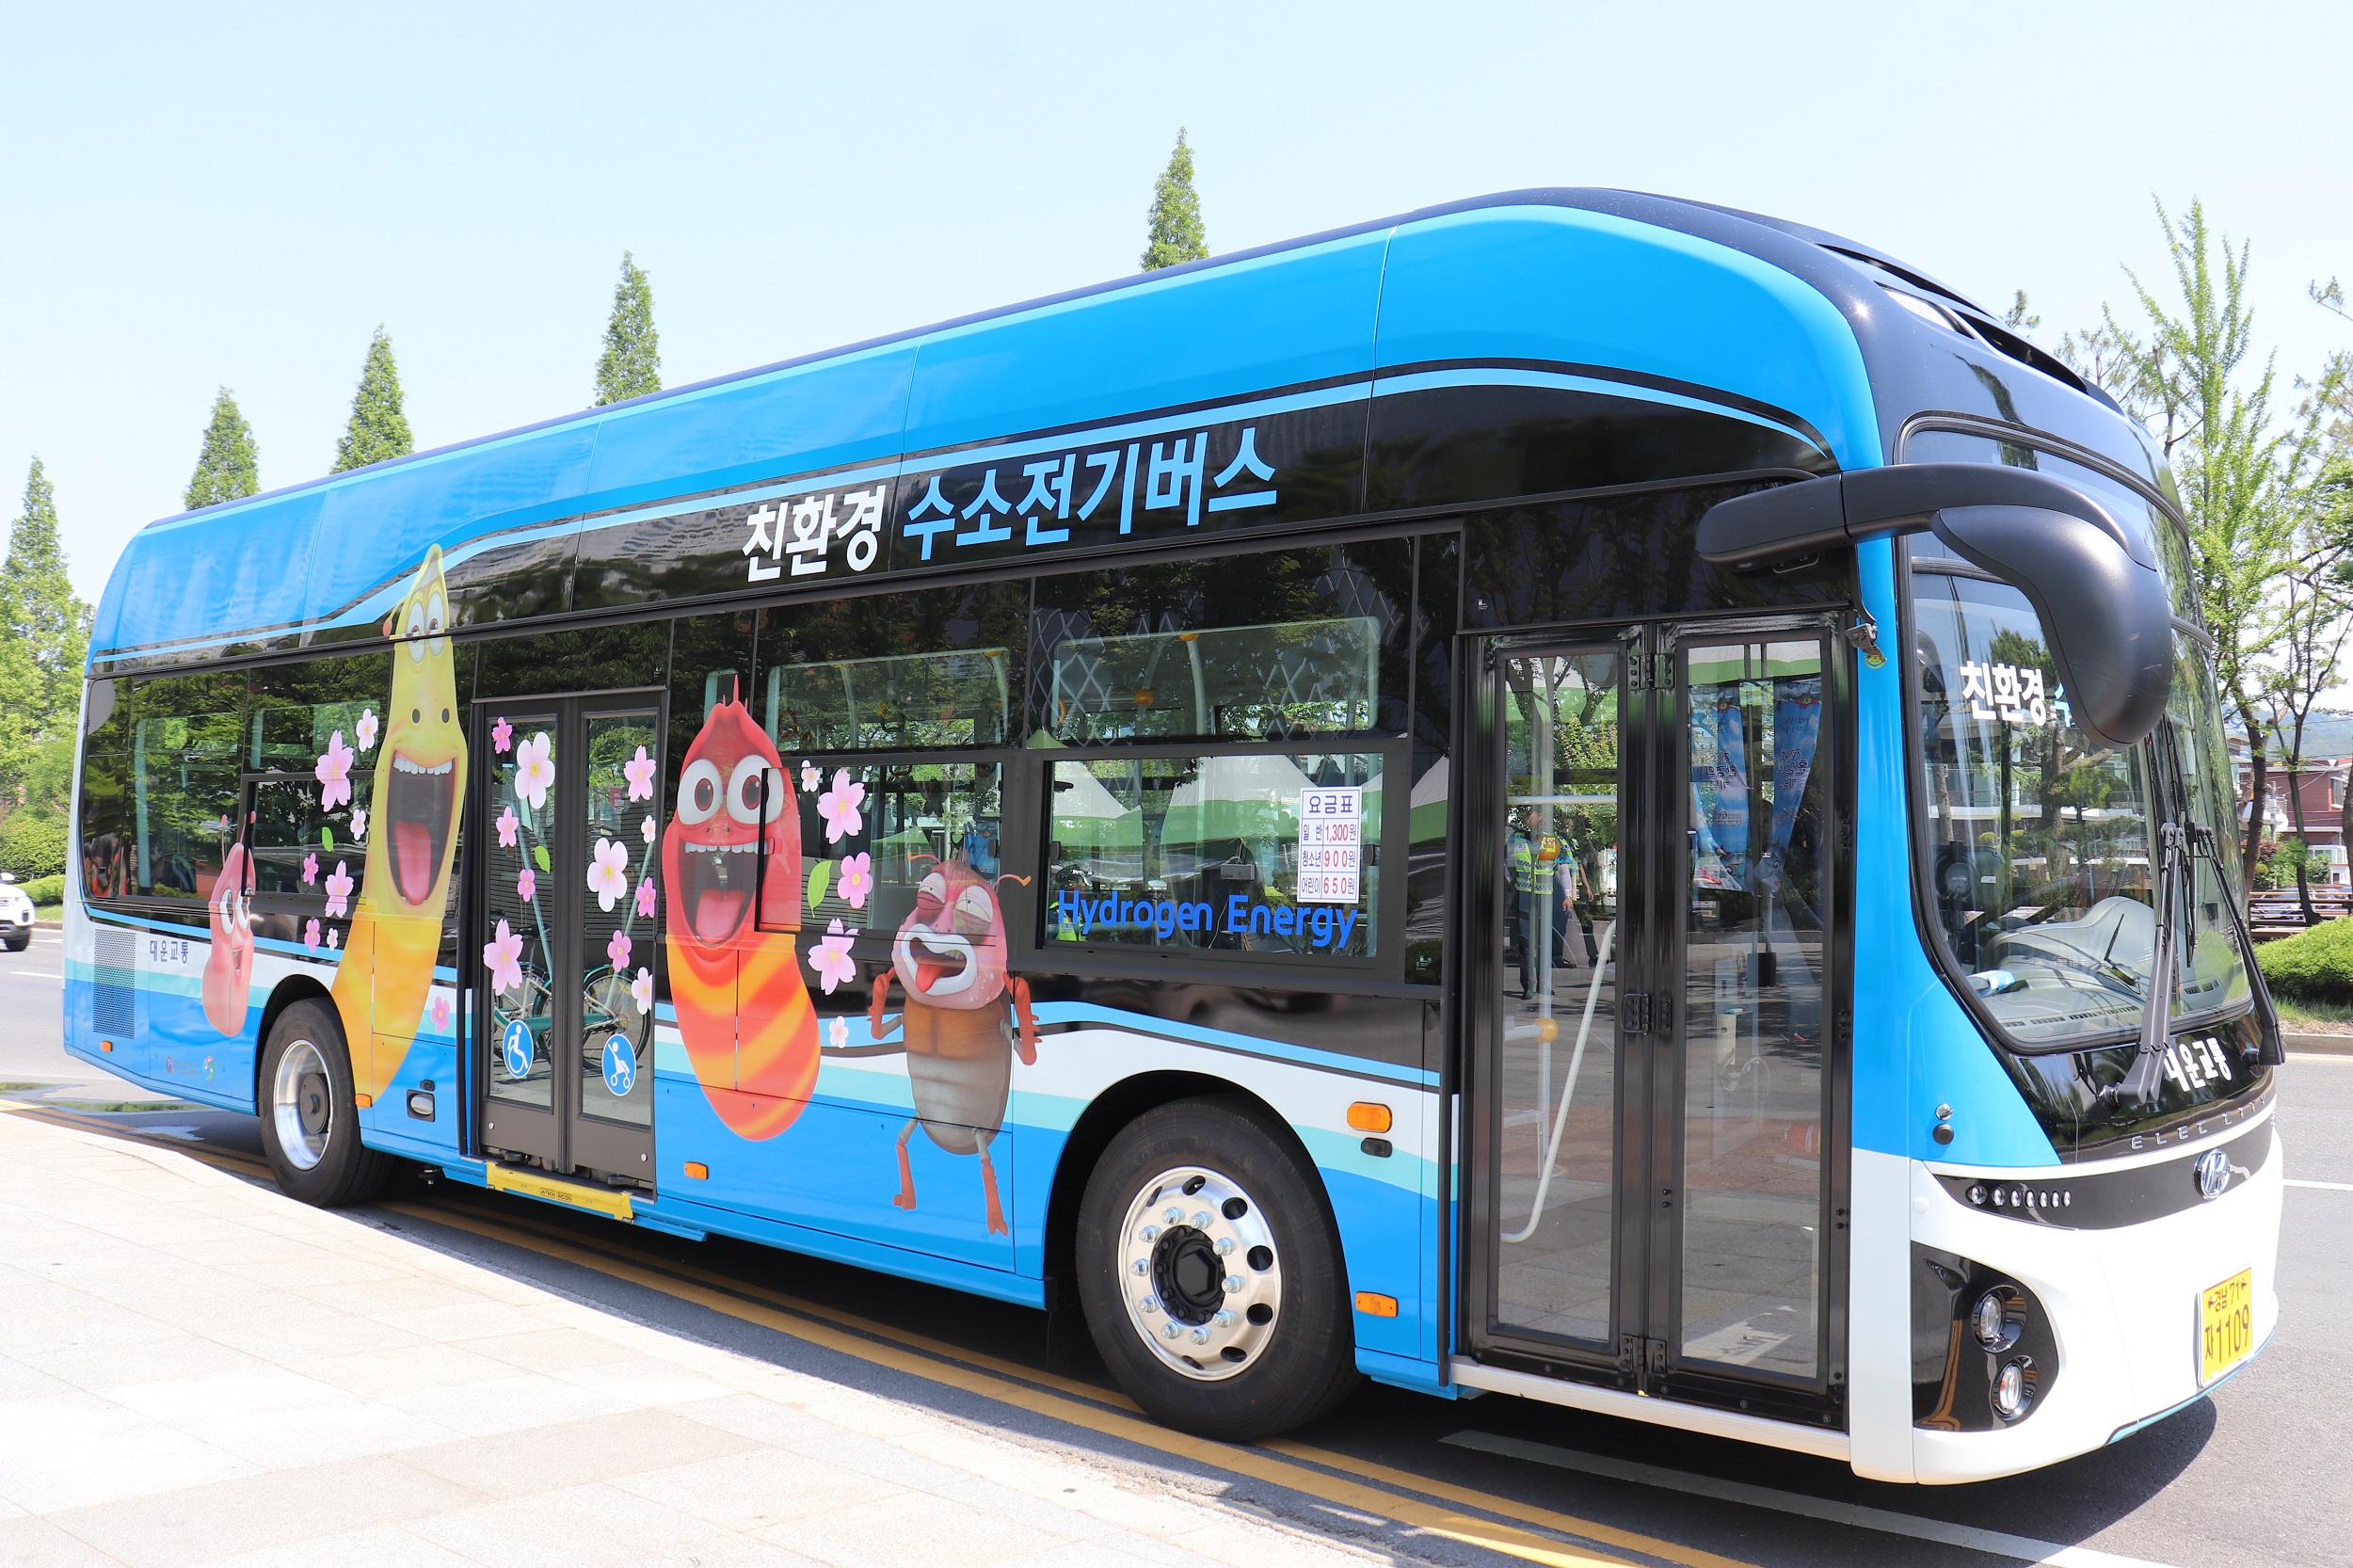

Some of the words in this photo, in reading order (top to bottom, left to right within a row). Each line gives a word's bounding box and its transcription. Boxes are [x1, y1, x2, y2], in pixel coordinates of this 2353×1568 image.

[742, 484, 887, 583] 친환경
[903, 425, 1278, 562] 수소전기버스
[1960, 660, 2046, 726] 친환경
[1308, 795, 1353, 814] 요금표
[1303, 850, 1321, 867] 청소년
[1302, 877, 1321, 894] 어린이
[1058, 889, 1213, 938] Hydrogen
[1227, 895, 1358, 949] Energy
[150, 940, 189, 964] 대운교통
[2205, 1304, 2249, 1364] 자1109
